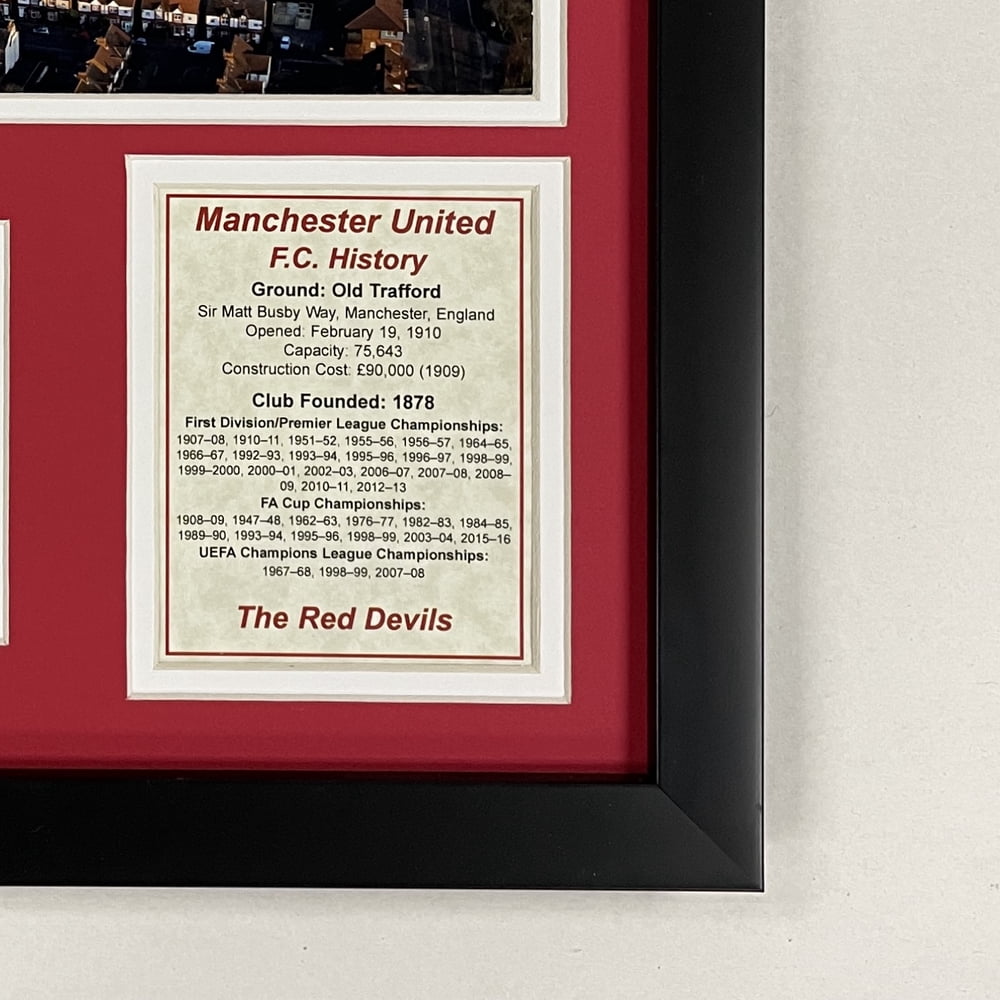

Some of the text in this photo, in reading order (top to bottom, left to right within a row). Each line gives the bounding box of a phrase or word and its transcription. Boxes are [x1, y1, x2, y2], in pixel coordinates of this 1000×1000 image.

[195, 206, 496, 235] Manchester United
[269, 247, 429, 276] F.C. History
[252, 282, 441, 299] Ground: Old Trafford
[198, 305, 494, 324] Sir Matt Busby Way, Manchester, England
[246, 324, 441, 341] Opened: February 19, 1910
[284, 343, 402, 360] Capacity: 75,643
[222, 362, 465, 380] Construction Cost: £90,000 (1909)
[252, 393, 434, 410] Club Founded: 1878
[186, 416, 503, 434] First Division/Premier League Championships:
[280, 481, 297, 493] 09,
[261, 497, 425, 513] FA Cup Championships:
[199, 546, 488, 564] UEFA Champions League Championships:
[238, 605, 453, 631] The Red Devils
